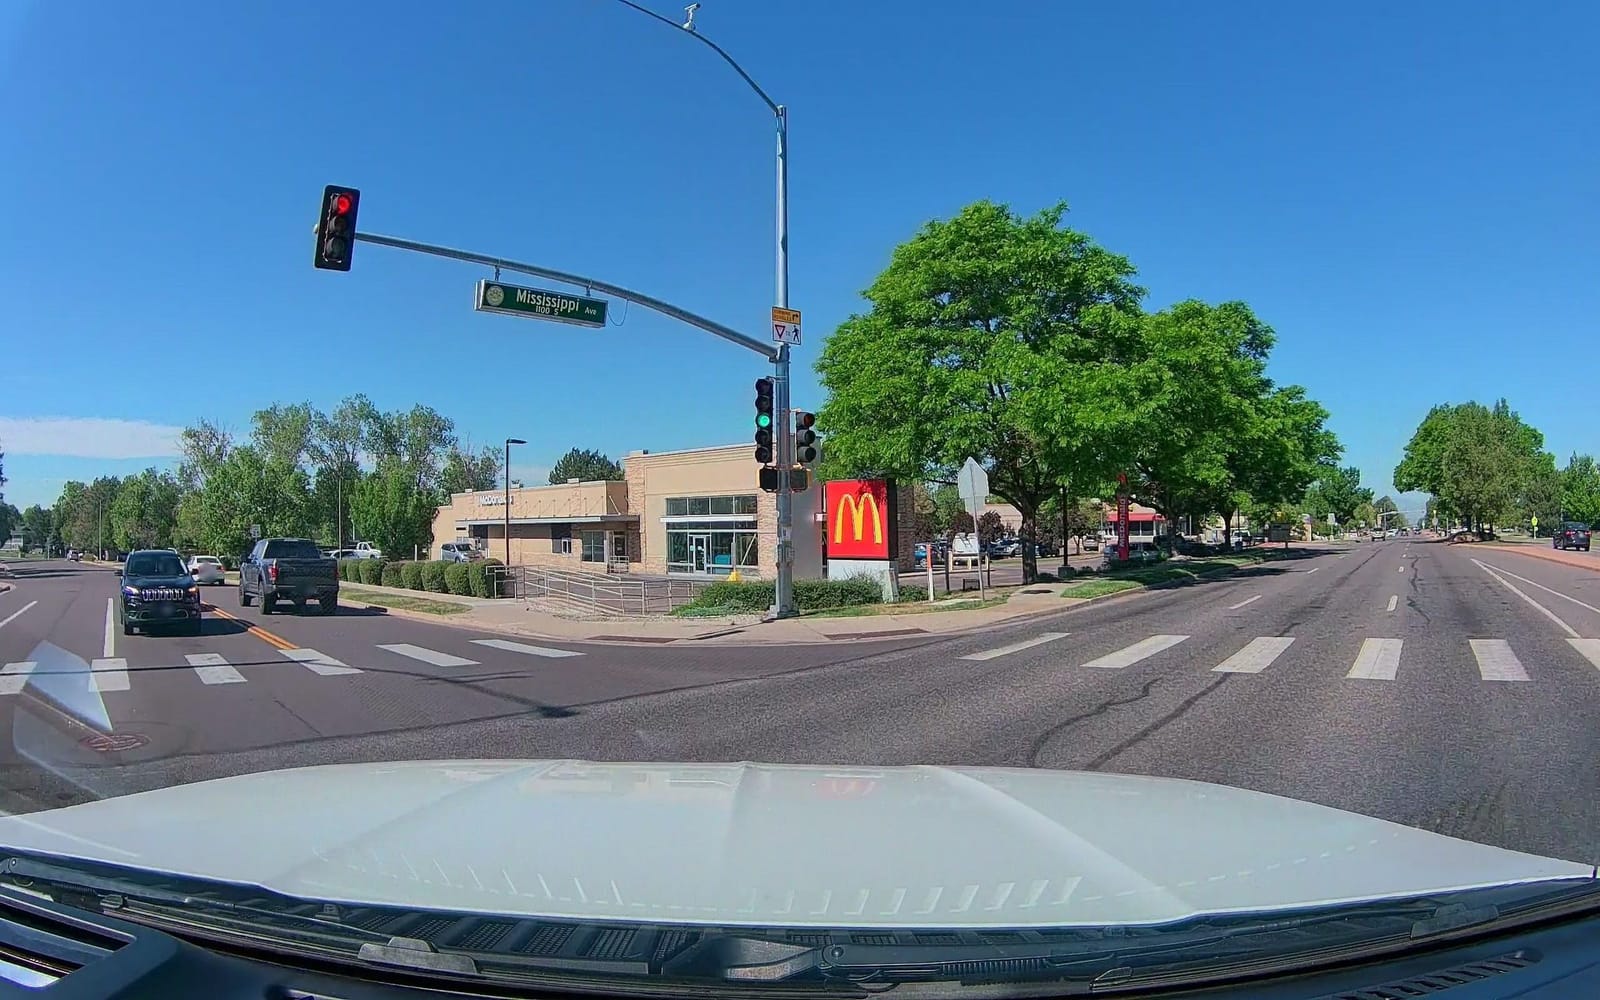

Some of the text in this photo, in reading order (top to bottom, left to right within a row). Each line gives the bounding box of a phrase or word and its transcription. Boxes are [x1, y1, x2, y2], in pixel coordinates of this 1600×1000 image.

[516, 288, 597, 316] Mississippi Ave
[536, 306, 550, 315] 1100
